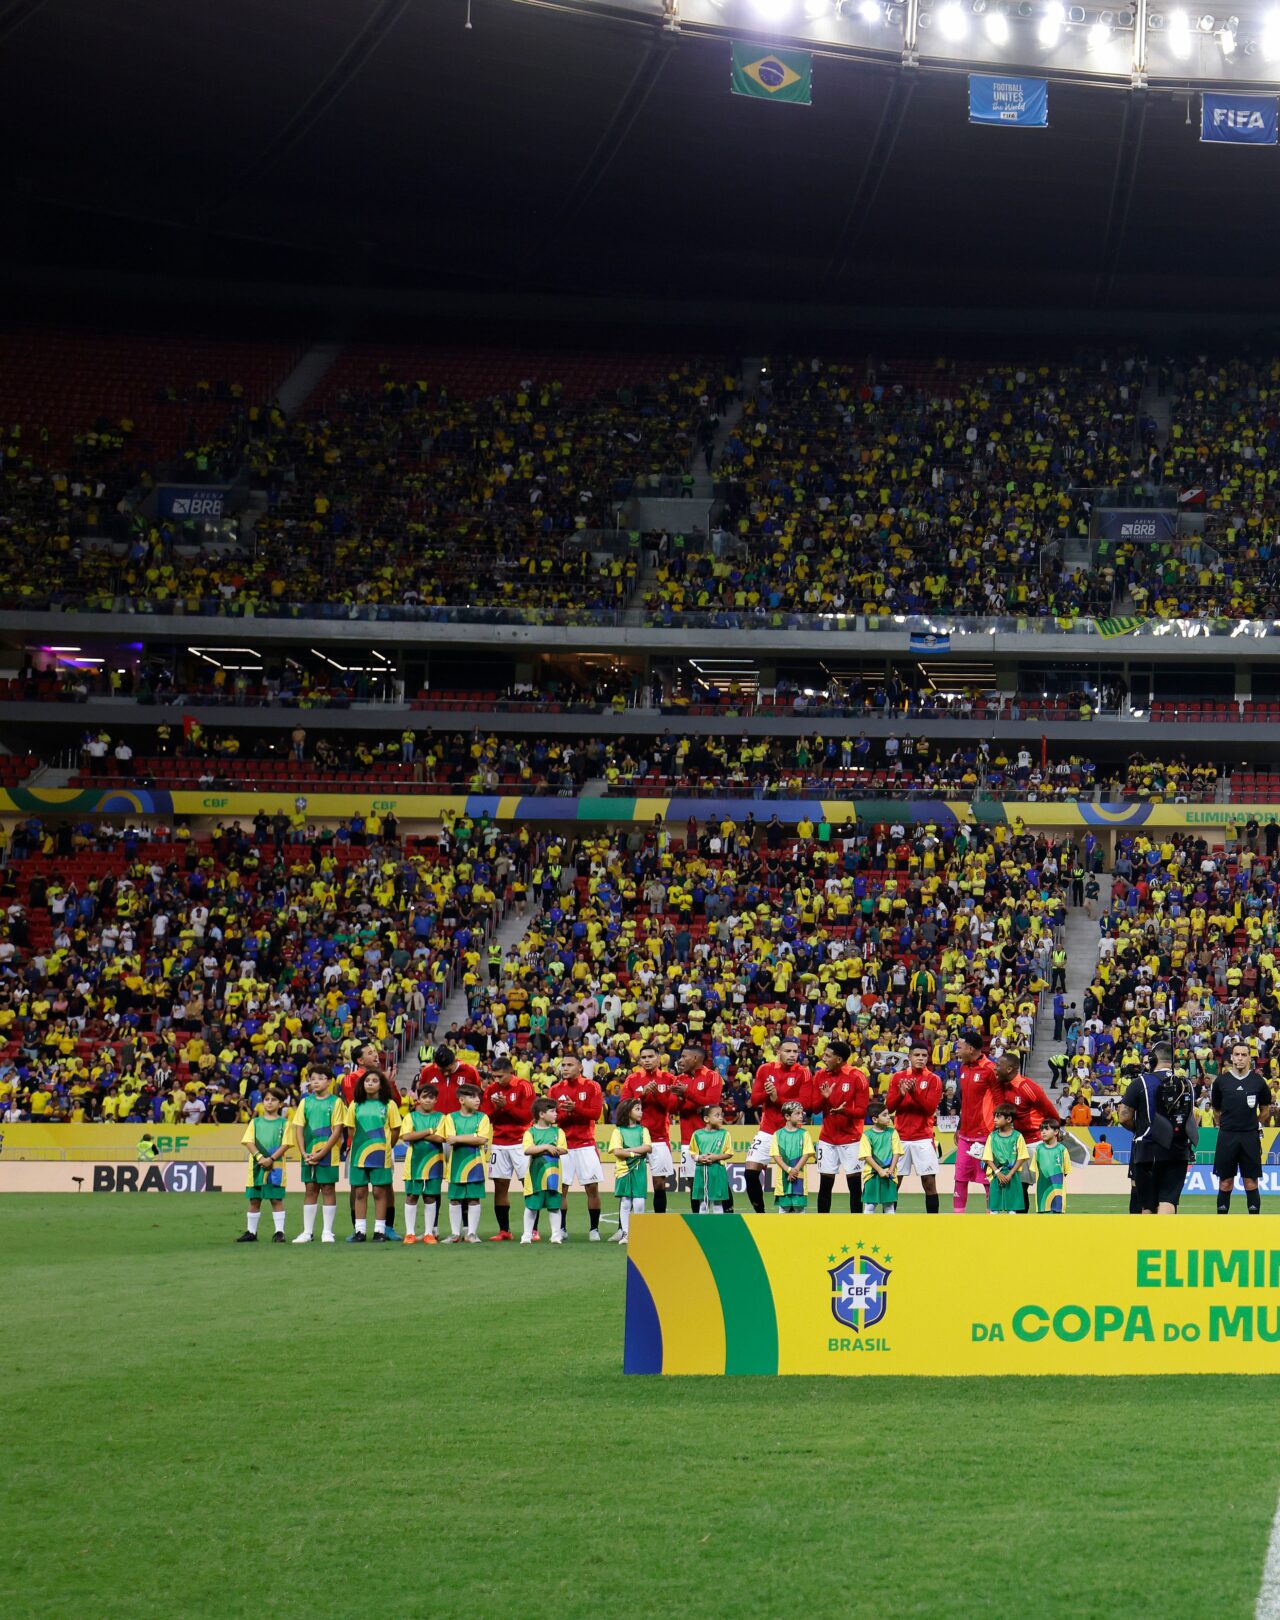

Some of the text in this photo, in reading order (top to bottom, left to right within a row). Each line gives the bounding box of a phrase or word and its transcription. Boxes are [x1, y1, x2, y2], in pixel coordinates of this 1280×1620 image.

[993, 83, 1023, 92] FOOTBALL
[993, 91, 1024, 103] UNITES
[1213, 108, 1265, 129] FIFA
[1133, 524, 1156, 536] BRB
[203, 799, 398, 811] CBF CBF
[141, 1136, 190, 1152] BF
[848, 1287, 871, 1296] CBF
[971, 1322, 1005, 1342] DA
[1012, 1304, 1155, 1343] COPA
[1163, 1322, 1201, 1342] DO
[828, 1338, 891, 1352] BRASIL
